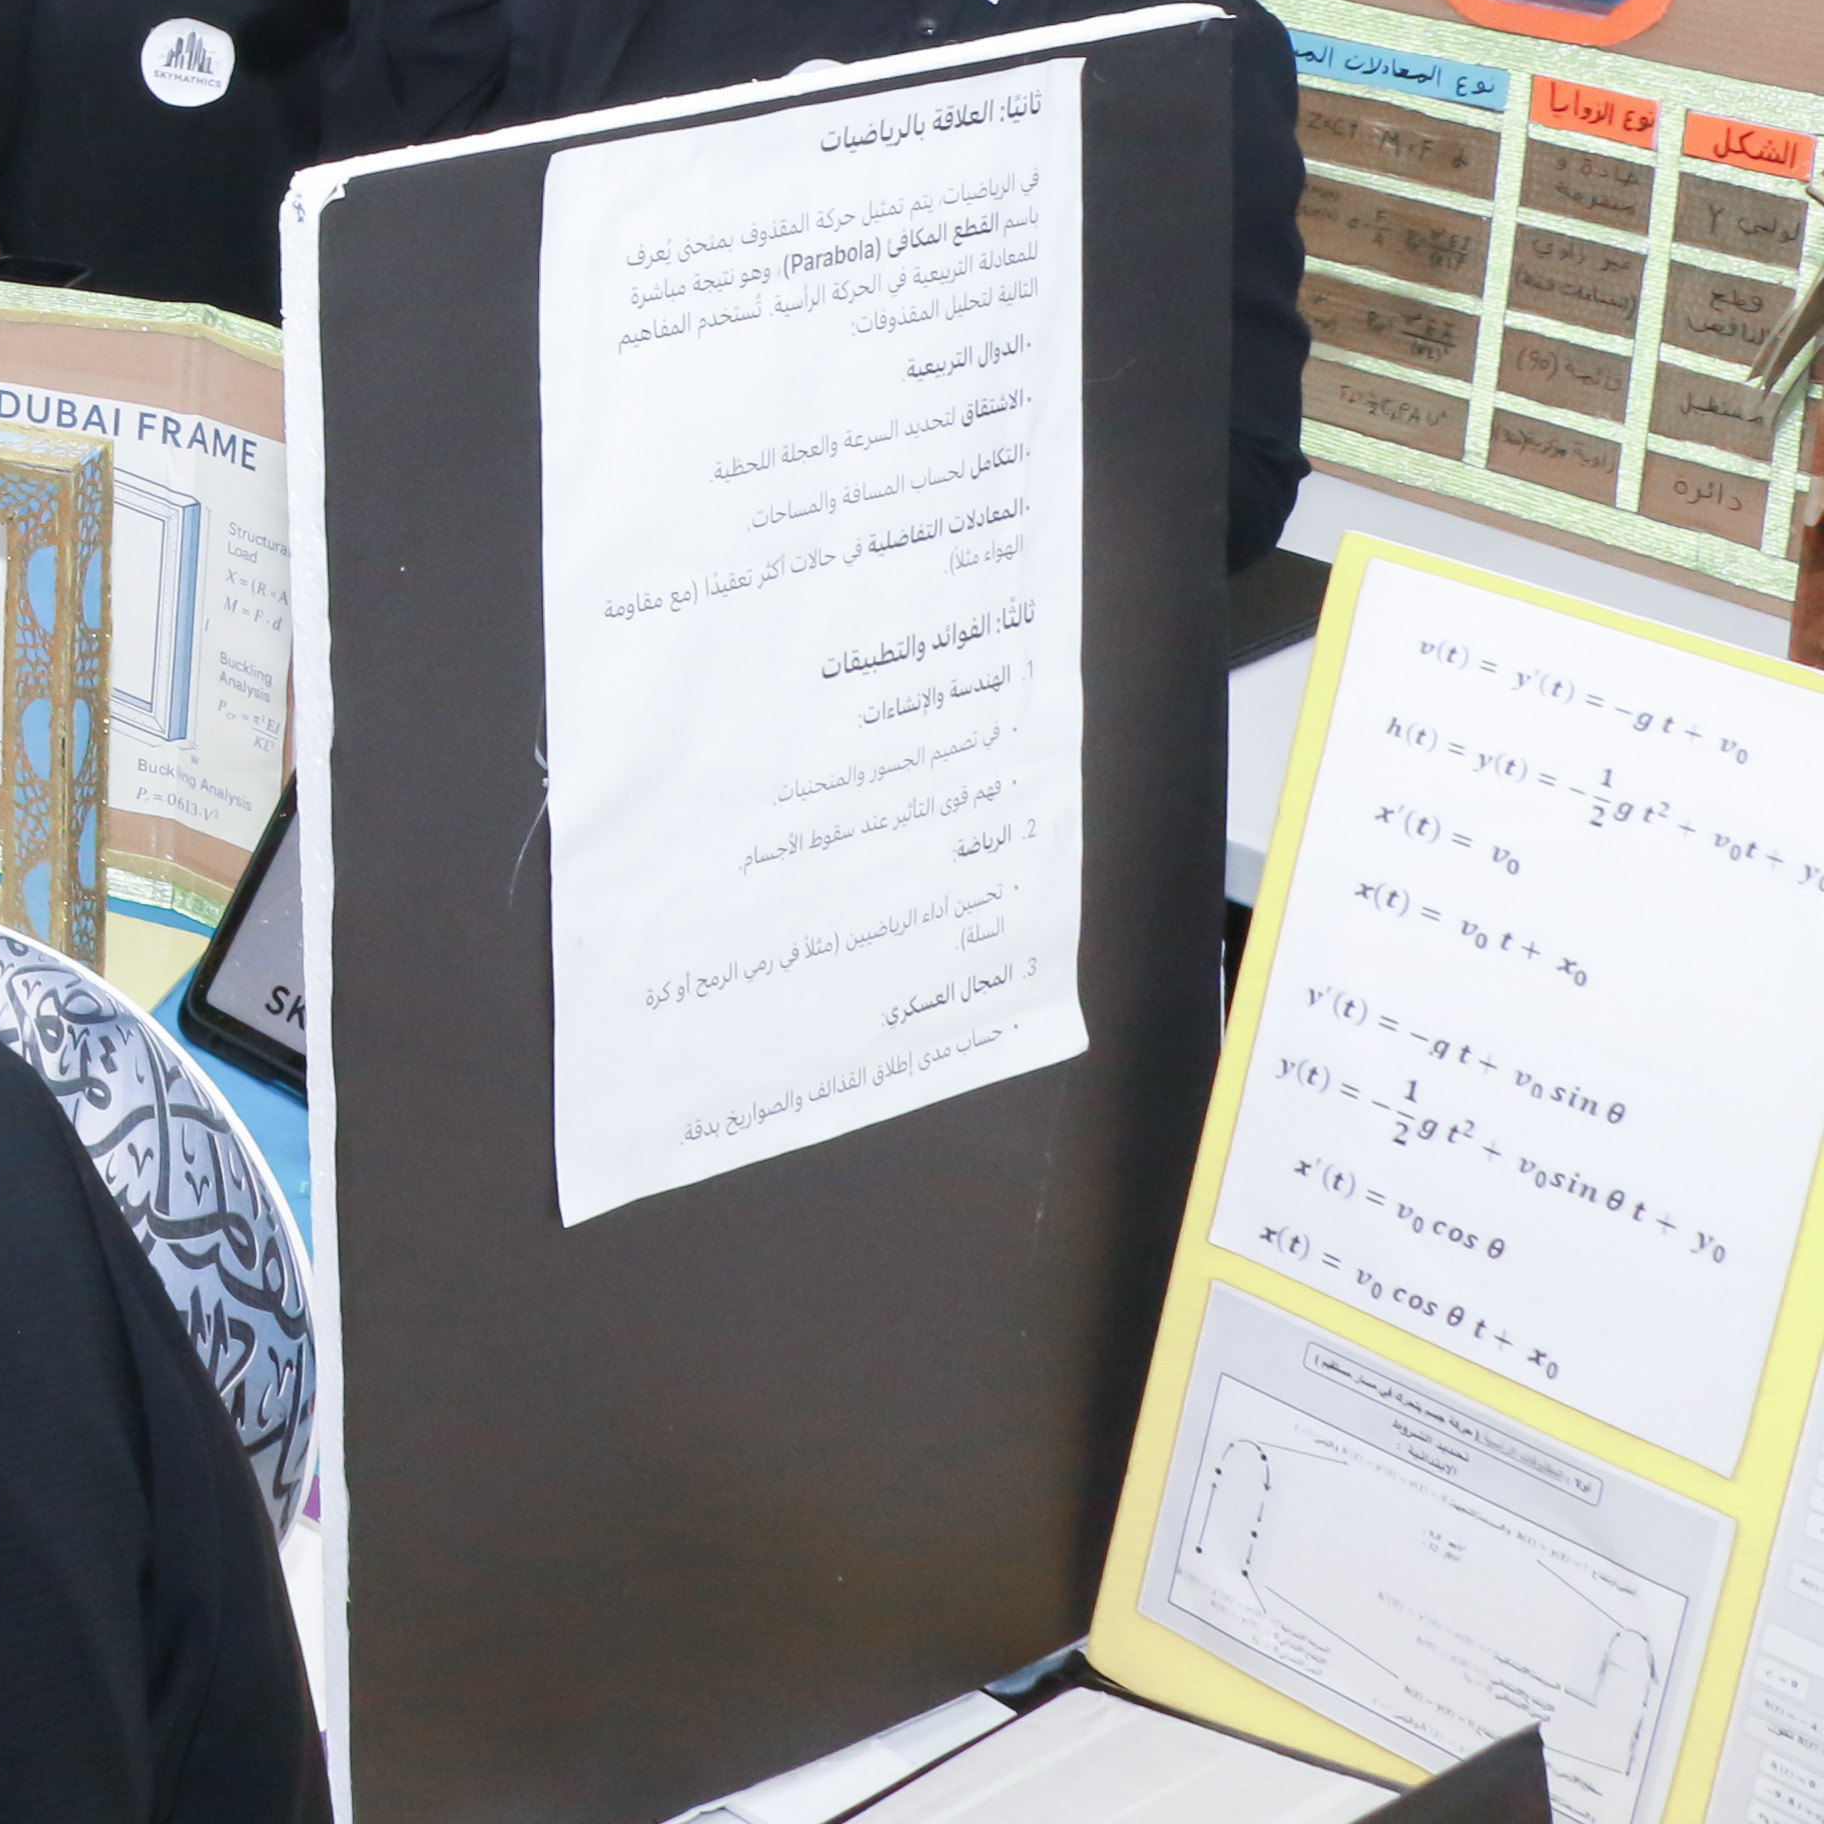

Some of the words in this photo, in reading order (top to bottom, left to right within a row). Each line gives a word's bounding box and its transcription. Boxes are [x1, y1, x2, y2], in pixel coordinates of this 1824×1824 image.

[153, 69, 222, 88] SKYMATHICS
[1456, 76, 1495, 96] نوع
[932, 99, 994, 131] العلاقة
[999, 91, 1041, 123] ثانيًا:
[819, 112, 925, 153] بالرياضيات
[1713, 127, 1797, 169] الشكل
[952, 212, 998, 247] القطع
[1002, 205, 1038, 236] باسم
[776, 235, 881, 280] (Parabola)،
[887, 222, 947, 259] المكافئ
[630, 278, 686, 310] مباشرة
[692, 270, 734, 293] نتيجة
[738, 266, 771, 289] وهو
[997, 276, 1038, 306] التالية
[851, 298, 939, 336] المقذوفات:
[944, 286, 992, 321] لتحليل
[903, 406, 955, 438] لتحديد
[961, 388, 1023, 428] الاشتقاق
[137, 412, 258, 471] FRAME
[780, 434, 838, 463] والعجلة
[843, 419, 898, 451] السرعة
[709, 447, 775, 483] اللحظية.
[910, 458, 964, 493] لحساب
[969, 443, 1023, 480] التكامل
[841, 473, 904, 504] المسافة
[747, 490, 837, 531] والمساحات.
[227, 540, 258, 564] Load
[228, 521, 291, 558] Structura
[931, 612, 990, 650] الفوائد
[996, 599, 1034, 633] ثالثًا:
[220, 651, 273, 687] Buckling
[821, 633, 925, 679] والتطبيقات
[1021, 658, 1033, 682] 1.
[219, 671, 271, 703] Analysis
[949, 664, 1010, 698] الهندسة
[858, 686, 944, 728] والإنشاءات:
[138, 758, 196, 789] Buckling
[200, 778, 252, 811] Analysis
[952, 823, 1011, 861] الرياضة:
[1021, 817, 1037, 840] 2.
[960, 963, 1012, 1003] المجال
[1022, 956, 1037, 979] 3.
[882, 982, 955, 1026] العسكري:
